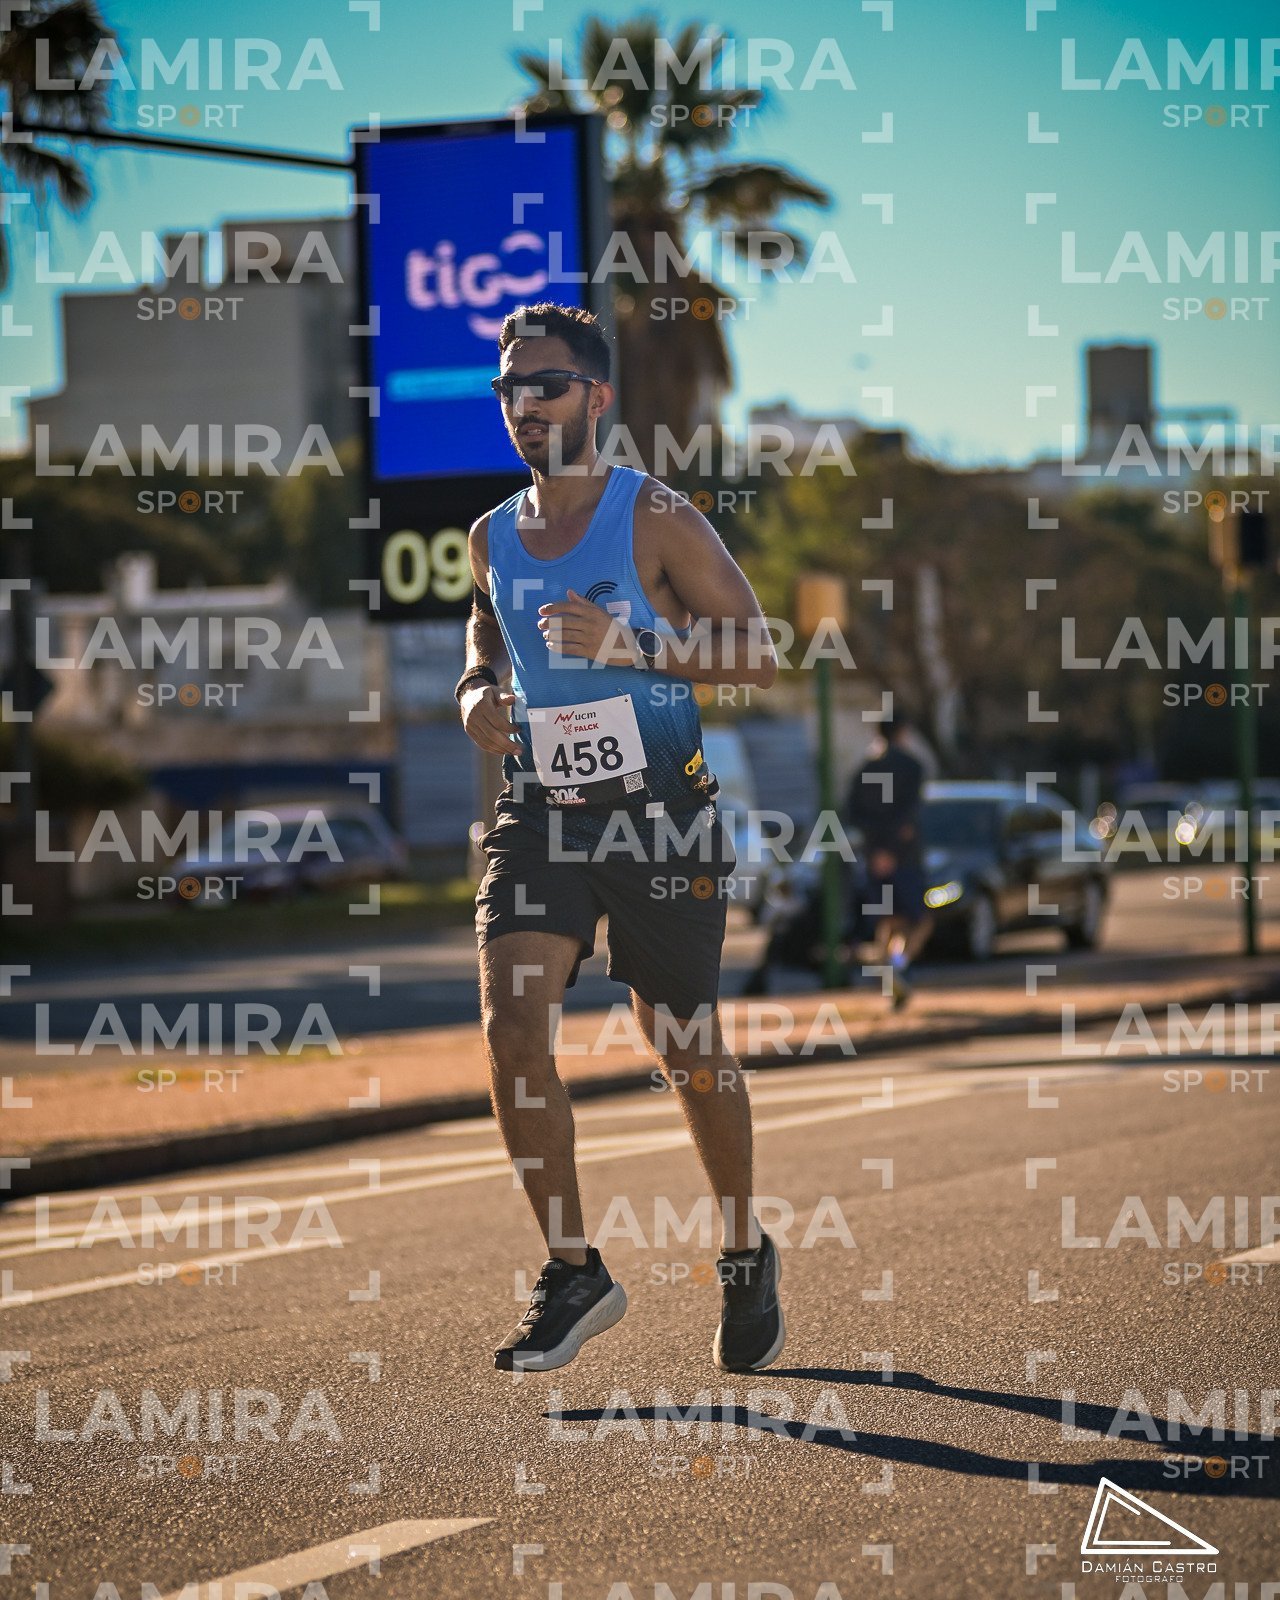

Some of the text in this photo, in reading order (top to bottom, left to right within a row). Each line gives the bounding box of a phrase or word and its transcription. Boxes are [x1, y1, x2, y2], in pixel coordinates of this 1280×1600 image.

[383, 528, 474, 604] 09
[574, 711, 597, 721] ucm
[574, 723, 600, 733] FALCK
[551, 735, 624, 778] 458
[549, 787, 580, 803] 30K
